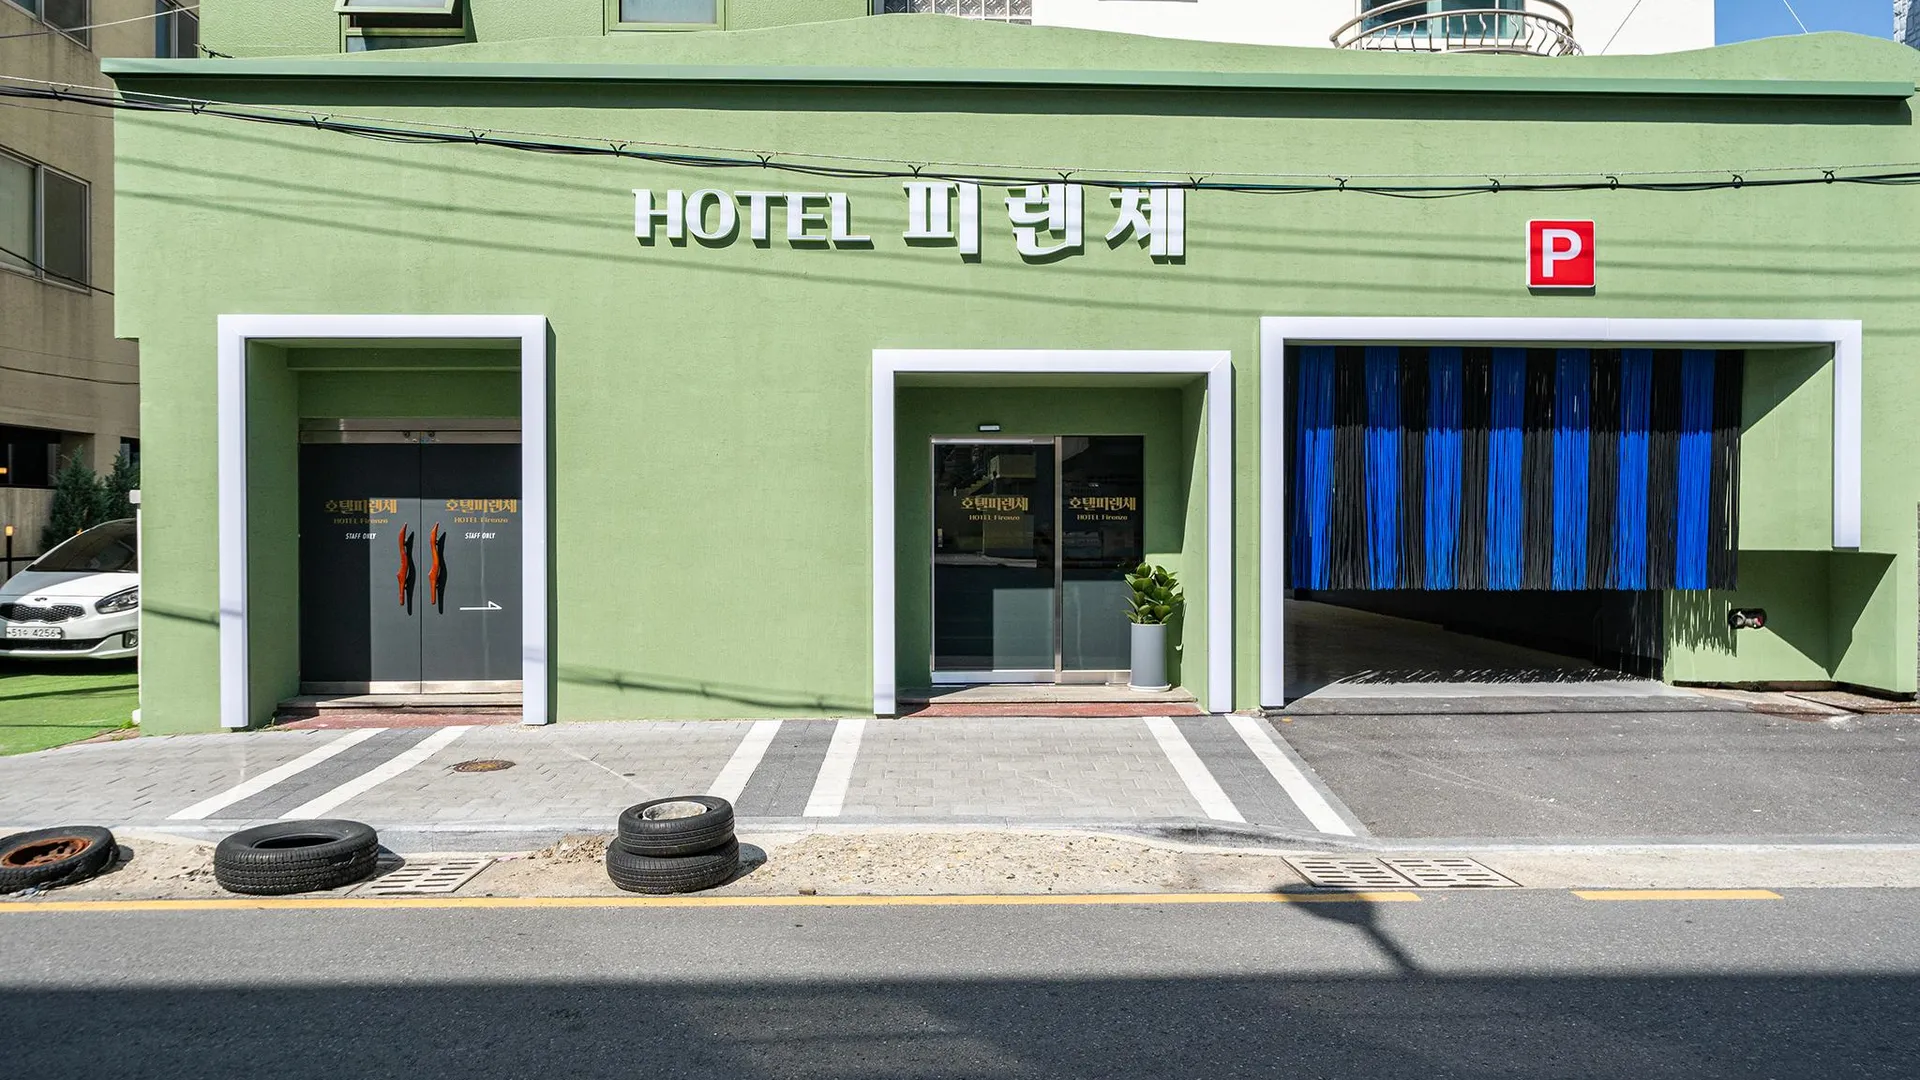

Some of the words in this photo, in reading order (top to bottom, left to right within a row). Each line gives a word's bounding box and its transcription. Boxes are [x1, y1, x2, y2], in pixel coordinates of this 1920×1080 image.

[631, 187, 872, 245] HOTEL
[902, 180, 1186, 260] 피렌체
[1541, 228, 1582, 278] P
[324, 499, 397, 514] 호텔피렌체
[445, 499, 517, 513] 호텔피렌체
[961, 497, 1028, 511] 호텔피렌체
[1068, 497, 1136, 511] 호텔피렌체
[32, 628, 56, 638] 4256
